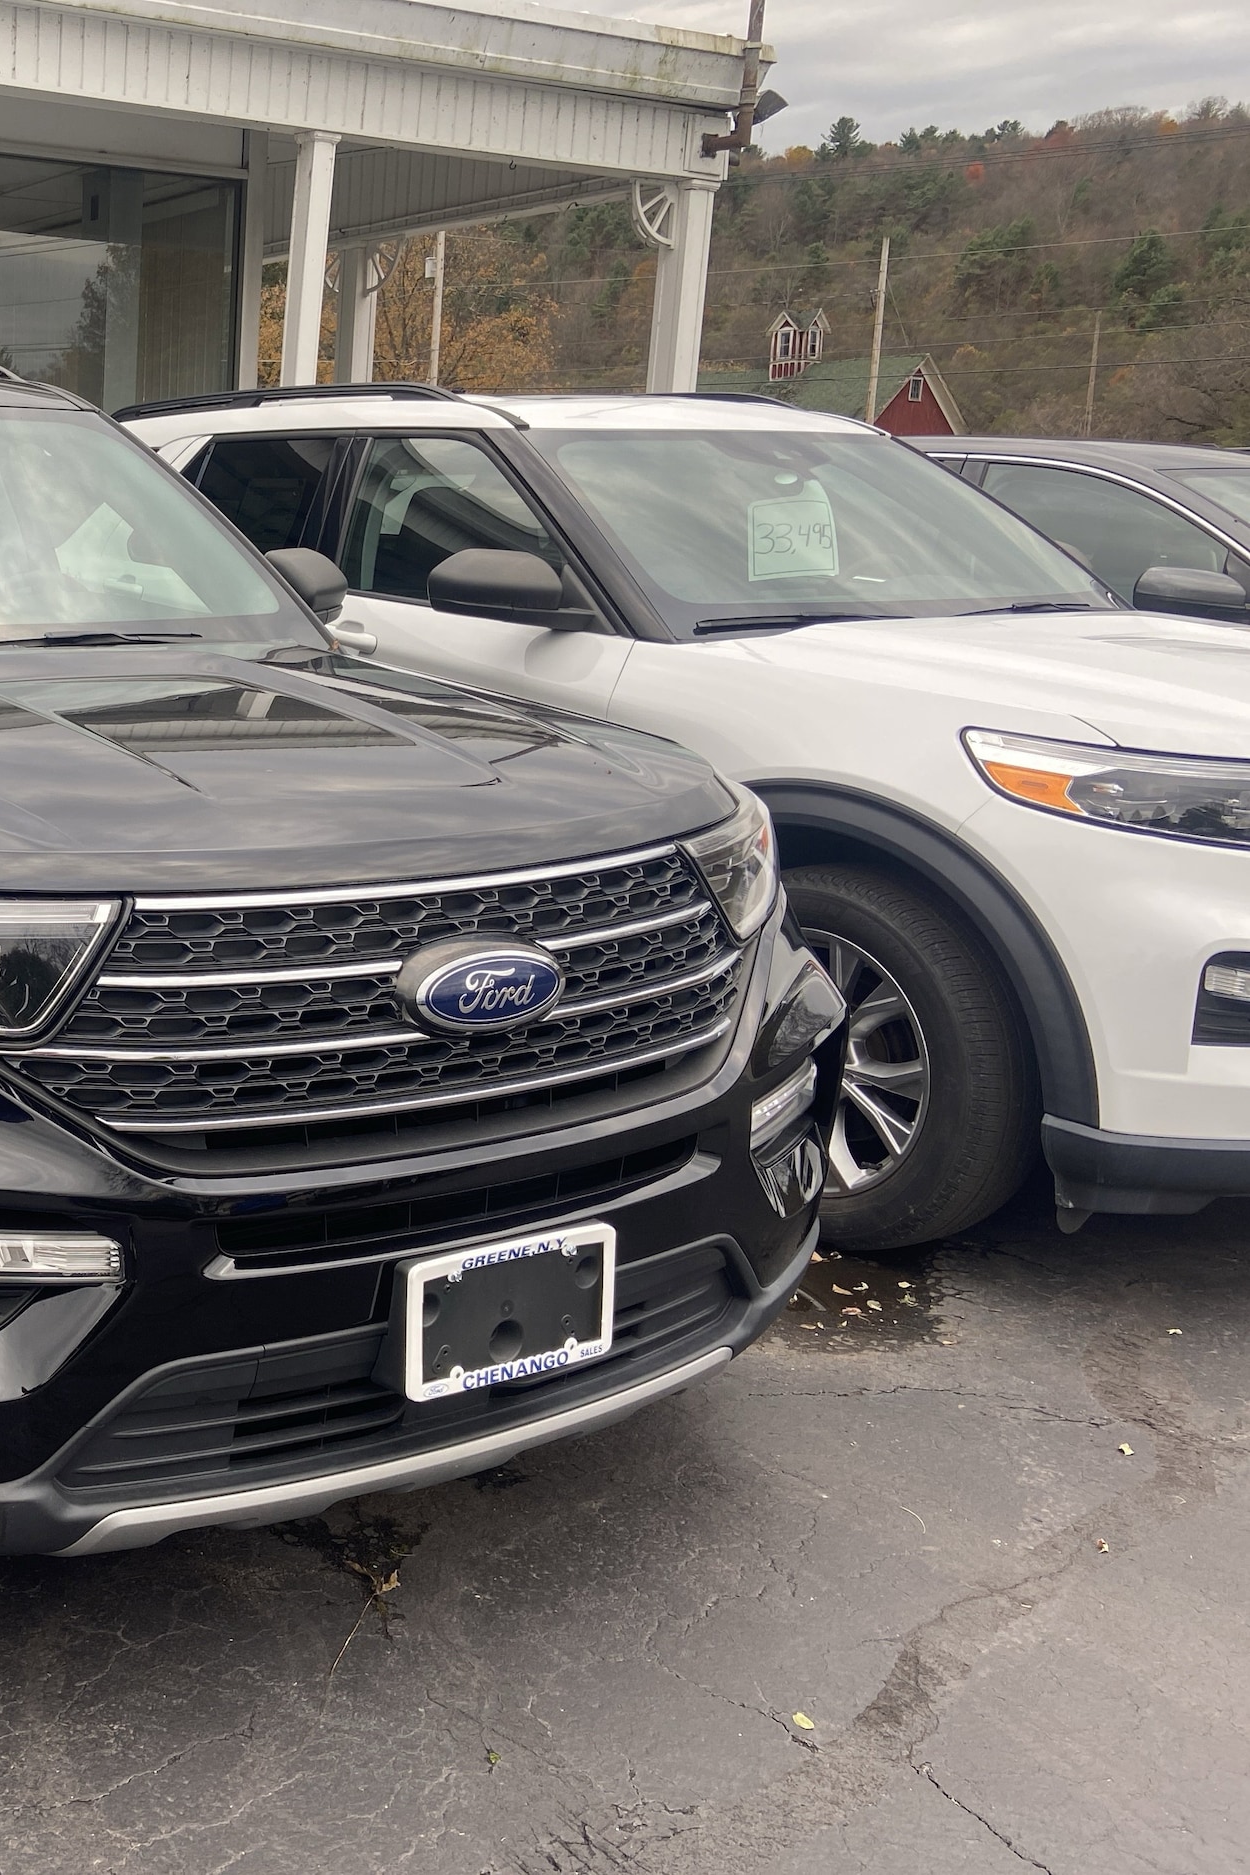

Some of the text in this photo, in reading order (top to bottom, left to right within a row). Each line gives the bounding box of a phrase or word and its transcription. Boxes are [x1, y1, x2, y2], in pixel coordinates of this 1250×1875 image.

[754, 522, 832, 555] 33,495
[458, 967, 536, 1015] Ford
[462, 1344, 604, 1391] CHENANGO SALES
